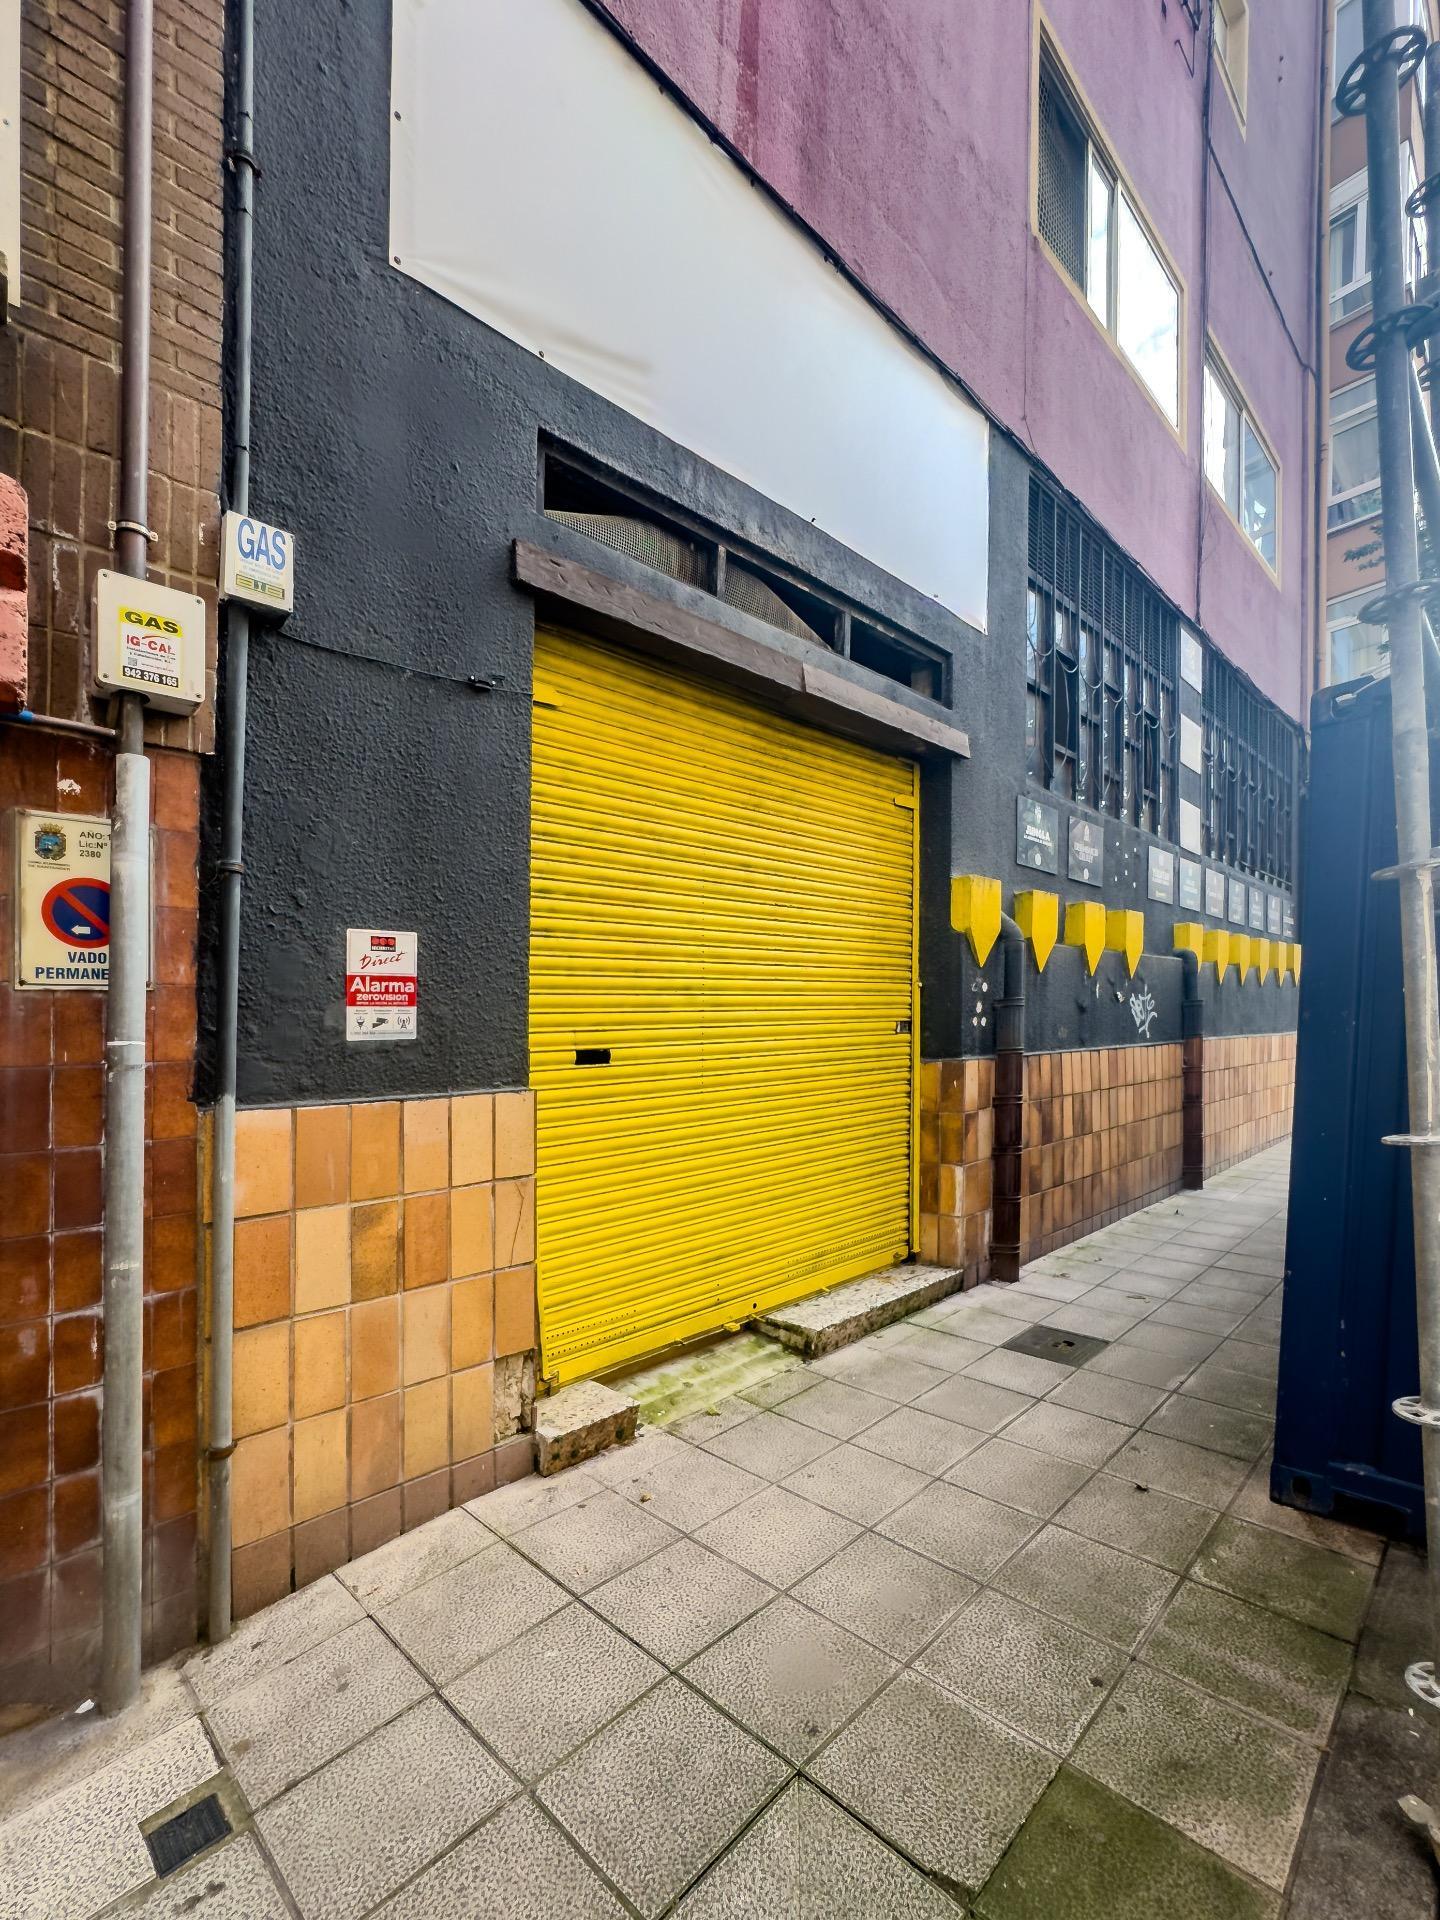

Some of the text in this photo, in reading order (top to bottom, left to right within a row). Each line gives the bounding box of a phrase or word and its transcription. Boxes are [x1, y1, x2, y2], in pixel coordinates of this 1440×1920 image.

[237, 518, 287, 571] GAS
[124, 611, 179, 634] GAS
[124, 667, 142, 679] 942
[143, 671, 160, 683] 376
[161, 675, 178, 687] 165
[79, 849, 102, 858] 2380
[67, 951, 107, 964] VADO
[359, 950, 406, 970] Direct
[35, 966, 109, 980] PERMANE
[350, 976, 415, 993] Alarma
[356, 993, 409, 1002] zerovision
